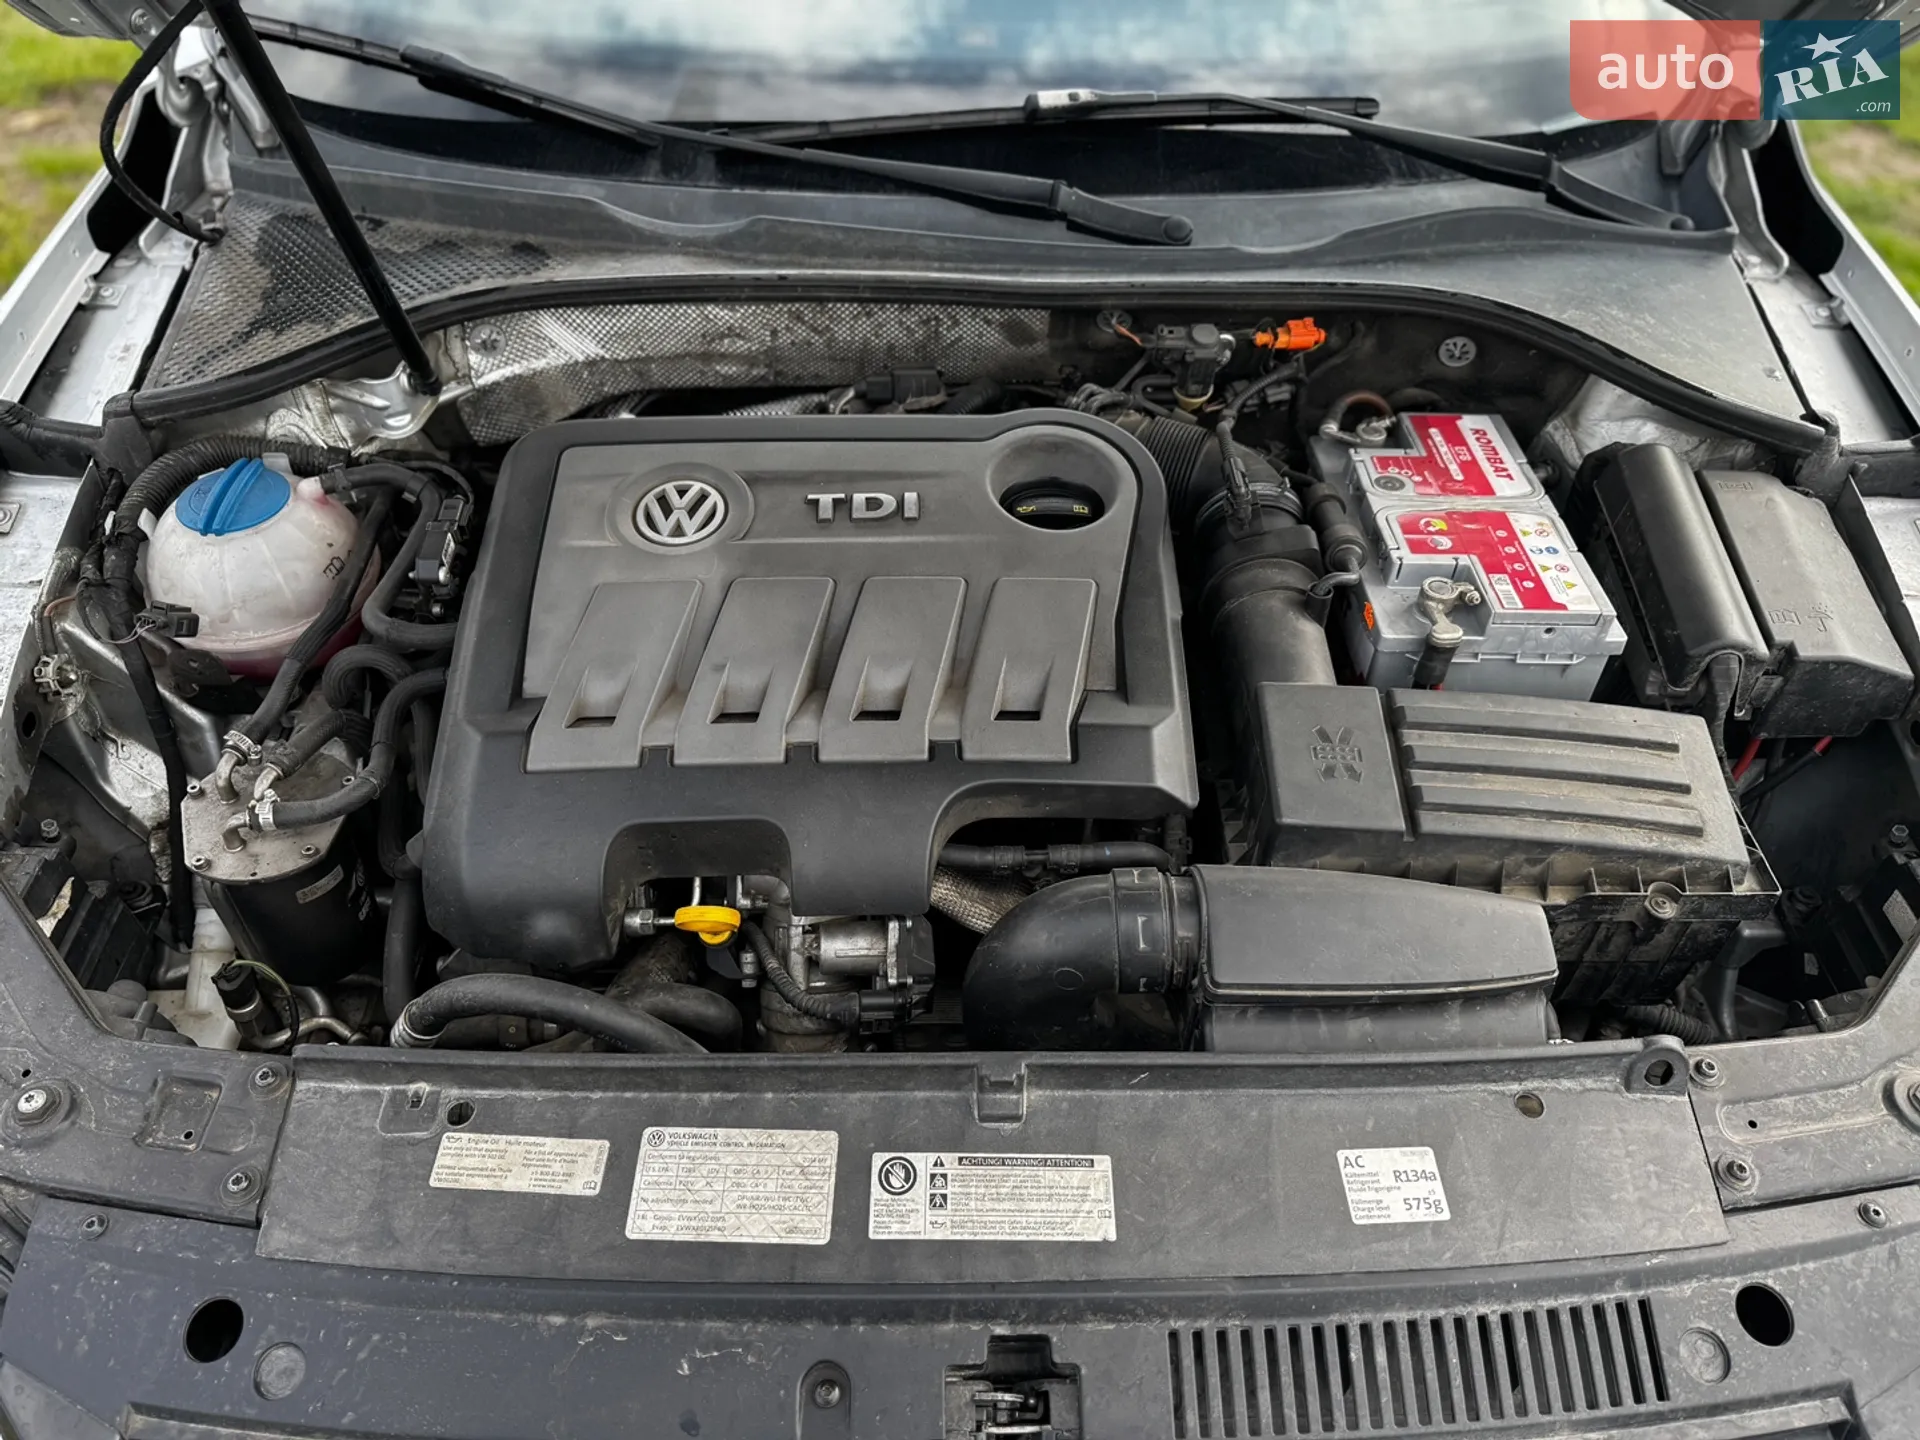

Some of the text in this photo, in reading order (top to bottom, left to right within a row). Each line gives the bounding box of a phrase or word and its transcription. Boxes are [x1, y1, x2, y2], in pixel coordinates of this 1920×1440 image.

[1469, 428, 1514, 481] ROMBAT
[805, 492, 921, 522] TDI
[1344, 1155, 1365, 1169] AC
[1393, 1169, 1437, 1183] R134a
[1403, 1198, 1444, 1214] 575g
